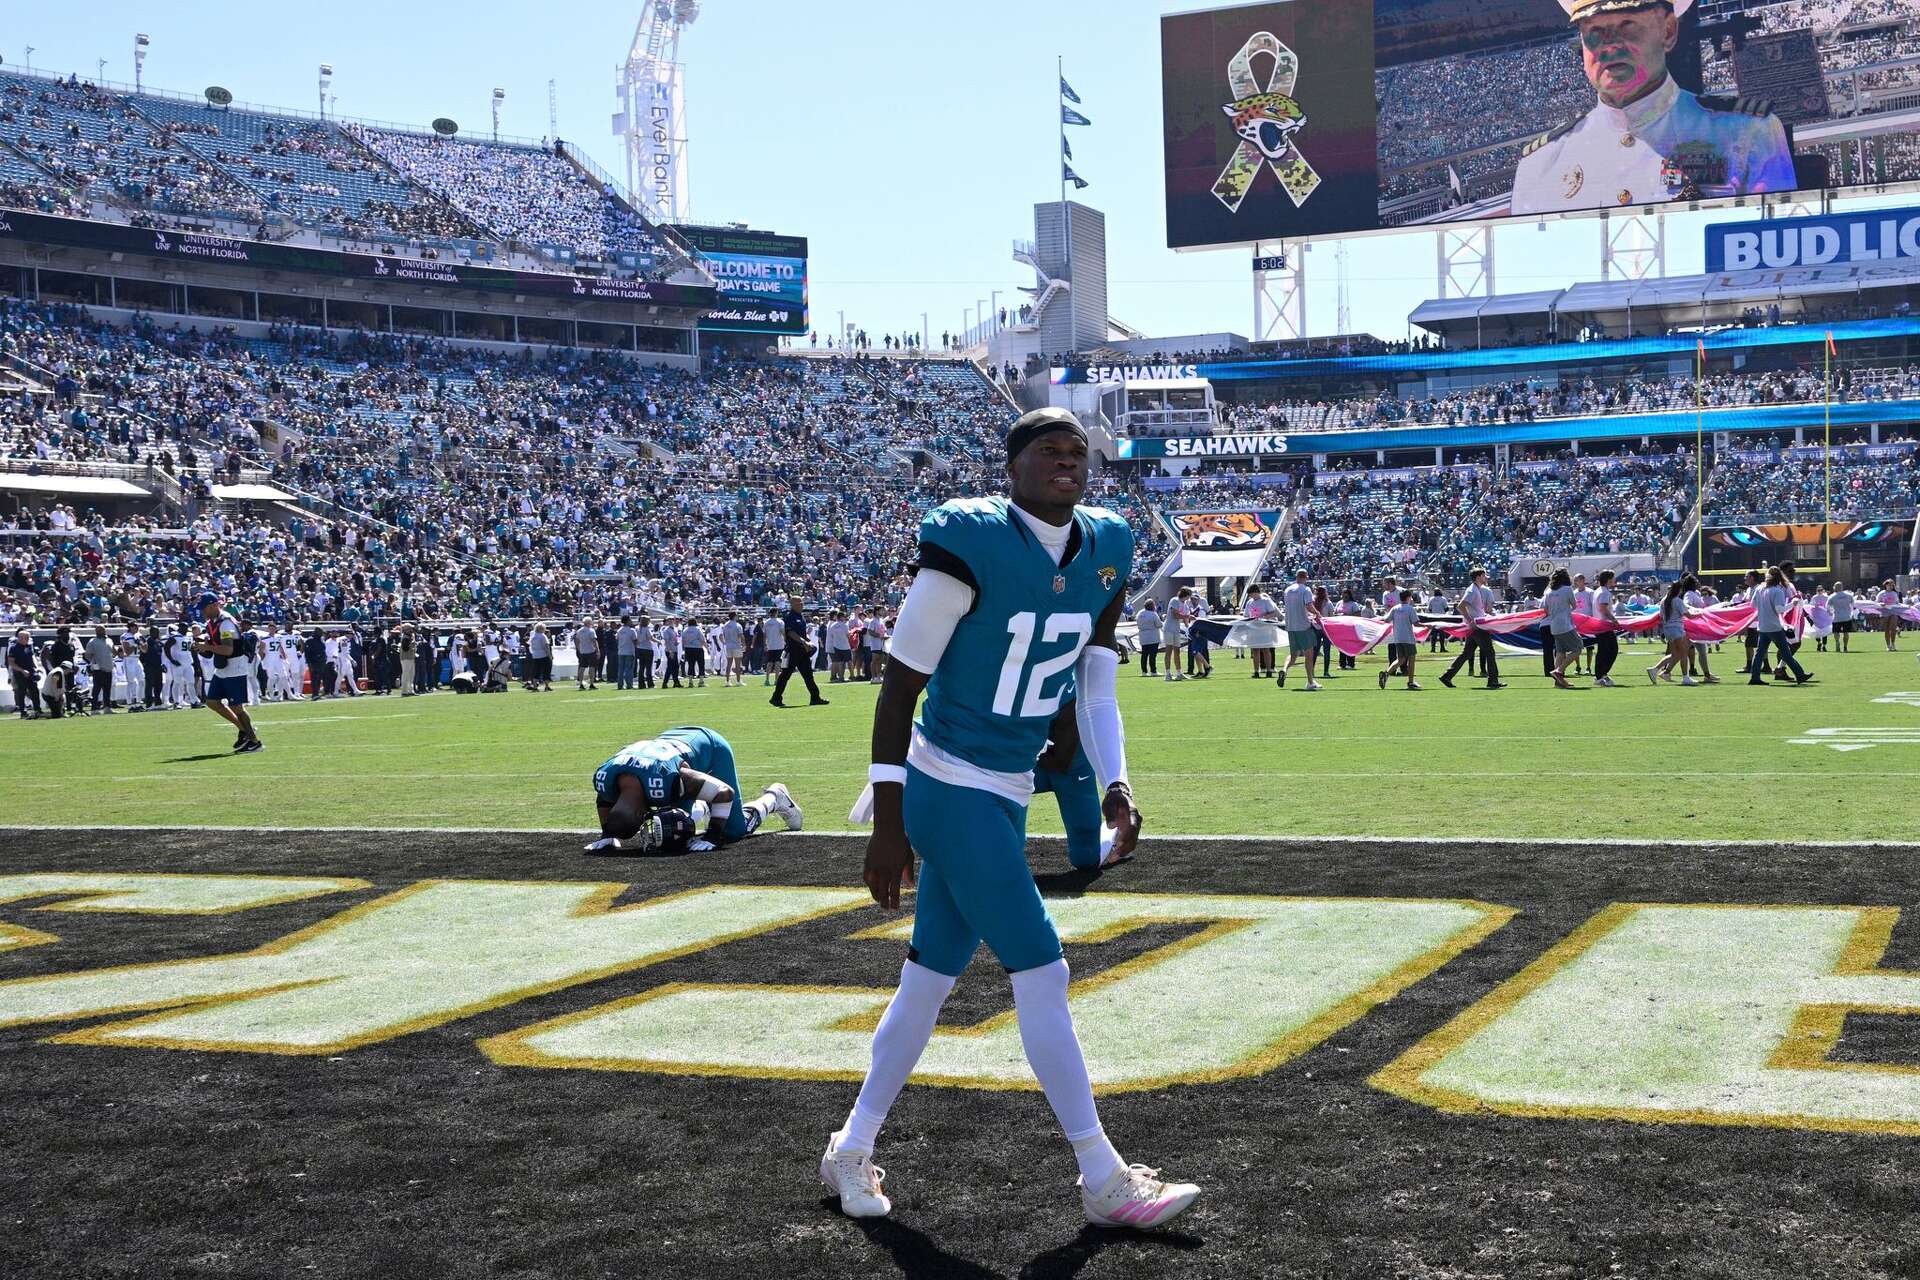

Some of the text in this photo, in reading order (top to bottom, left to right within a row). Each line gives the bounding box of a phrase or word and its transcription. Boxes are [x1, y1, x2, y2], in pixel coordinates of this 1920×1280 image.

[651, 106, 673, 205] EverBank
[155, 241, 172, 252] UNF
[183, 234, 234, 249] UNIVERSITY
[1723, 225, 1841, 272] BUD
[179, 244, 249, 261] NORTH FLORIDA
[400, 260, 446, 271] UNIVERSITY
[1260, 257, 1284, 269] 6:02
[374, 266, 390, 276] UNF
[396, 268, 458, 283] NORTH FLORIDA
[774, 263, 795, 280] TO
[596, 279, 640, 289] UNIVERSITY
[752, 280, 781, 293] GAME
[592, 288, 652, 300] NORTH FLORIDA
[743, 310, 767, 321] Blue
[1086, 364, 1198, 384] SEAHAWKS
[1164, 436, 1288, 457] SEAHAWKS
[1536, 563, 1551, 572] 147
[269, 641, 281, 652] 57
[286, 639, 298, 649] 94
[991, 611, 1092, 718] 12
[596, 770, 607, 793] 65
[649, 777, 665, 799] 65
